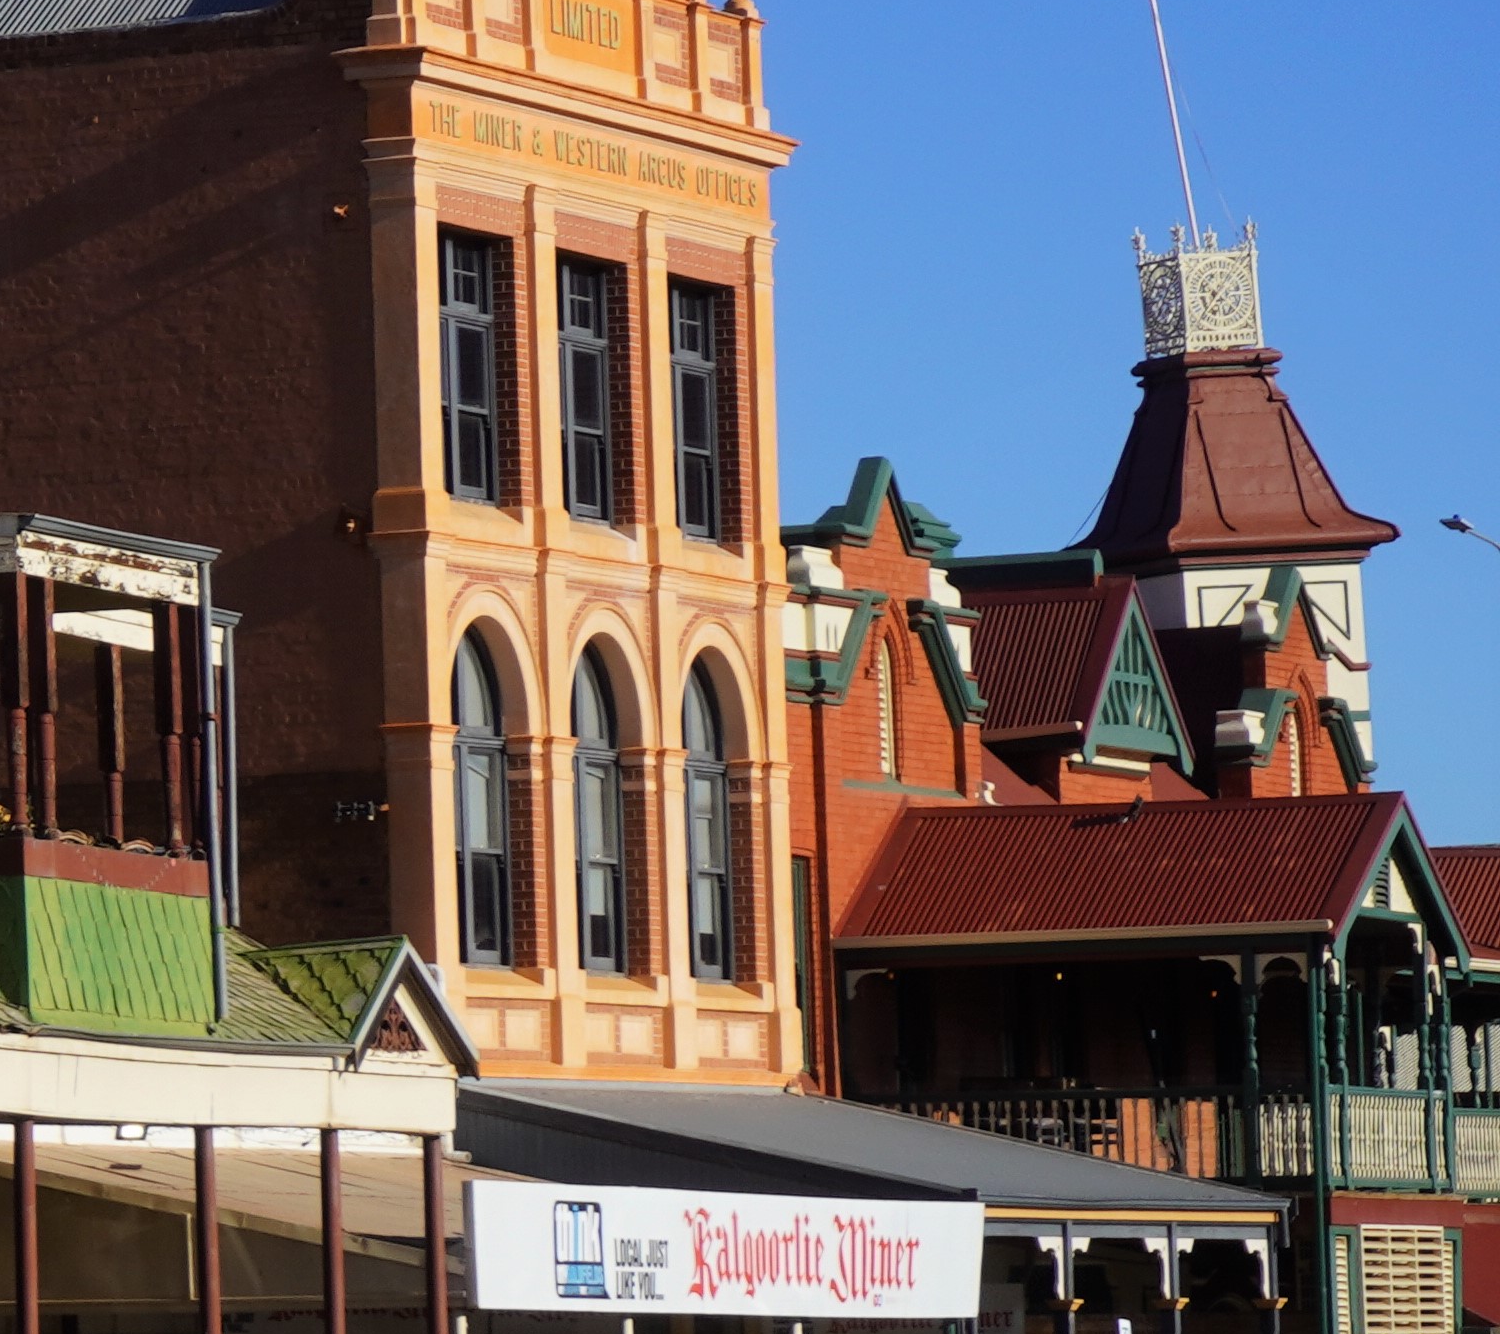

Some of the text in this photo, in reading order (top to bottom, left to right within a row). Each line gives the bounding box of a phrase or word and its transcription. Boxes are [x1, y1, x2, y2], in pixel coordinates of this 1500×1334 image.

[429, 100, 461, 138] THE
[473, 109, 523, 152] MINER
[532, 129, 543, 156] &
[555, 130, 628, 177] WESTERN
[695, 168, 758, 208] OFFICES
[614, 1238, 668, 1268] LOCAL JUST
[683, 1207, 920, 1303] Kalgoorlie Miner
[616, 1271, 635, 1299] LIKE
